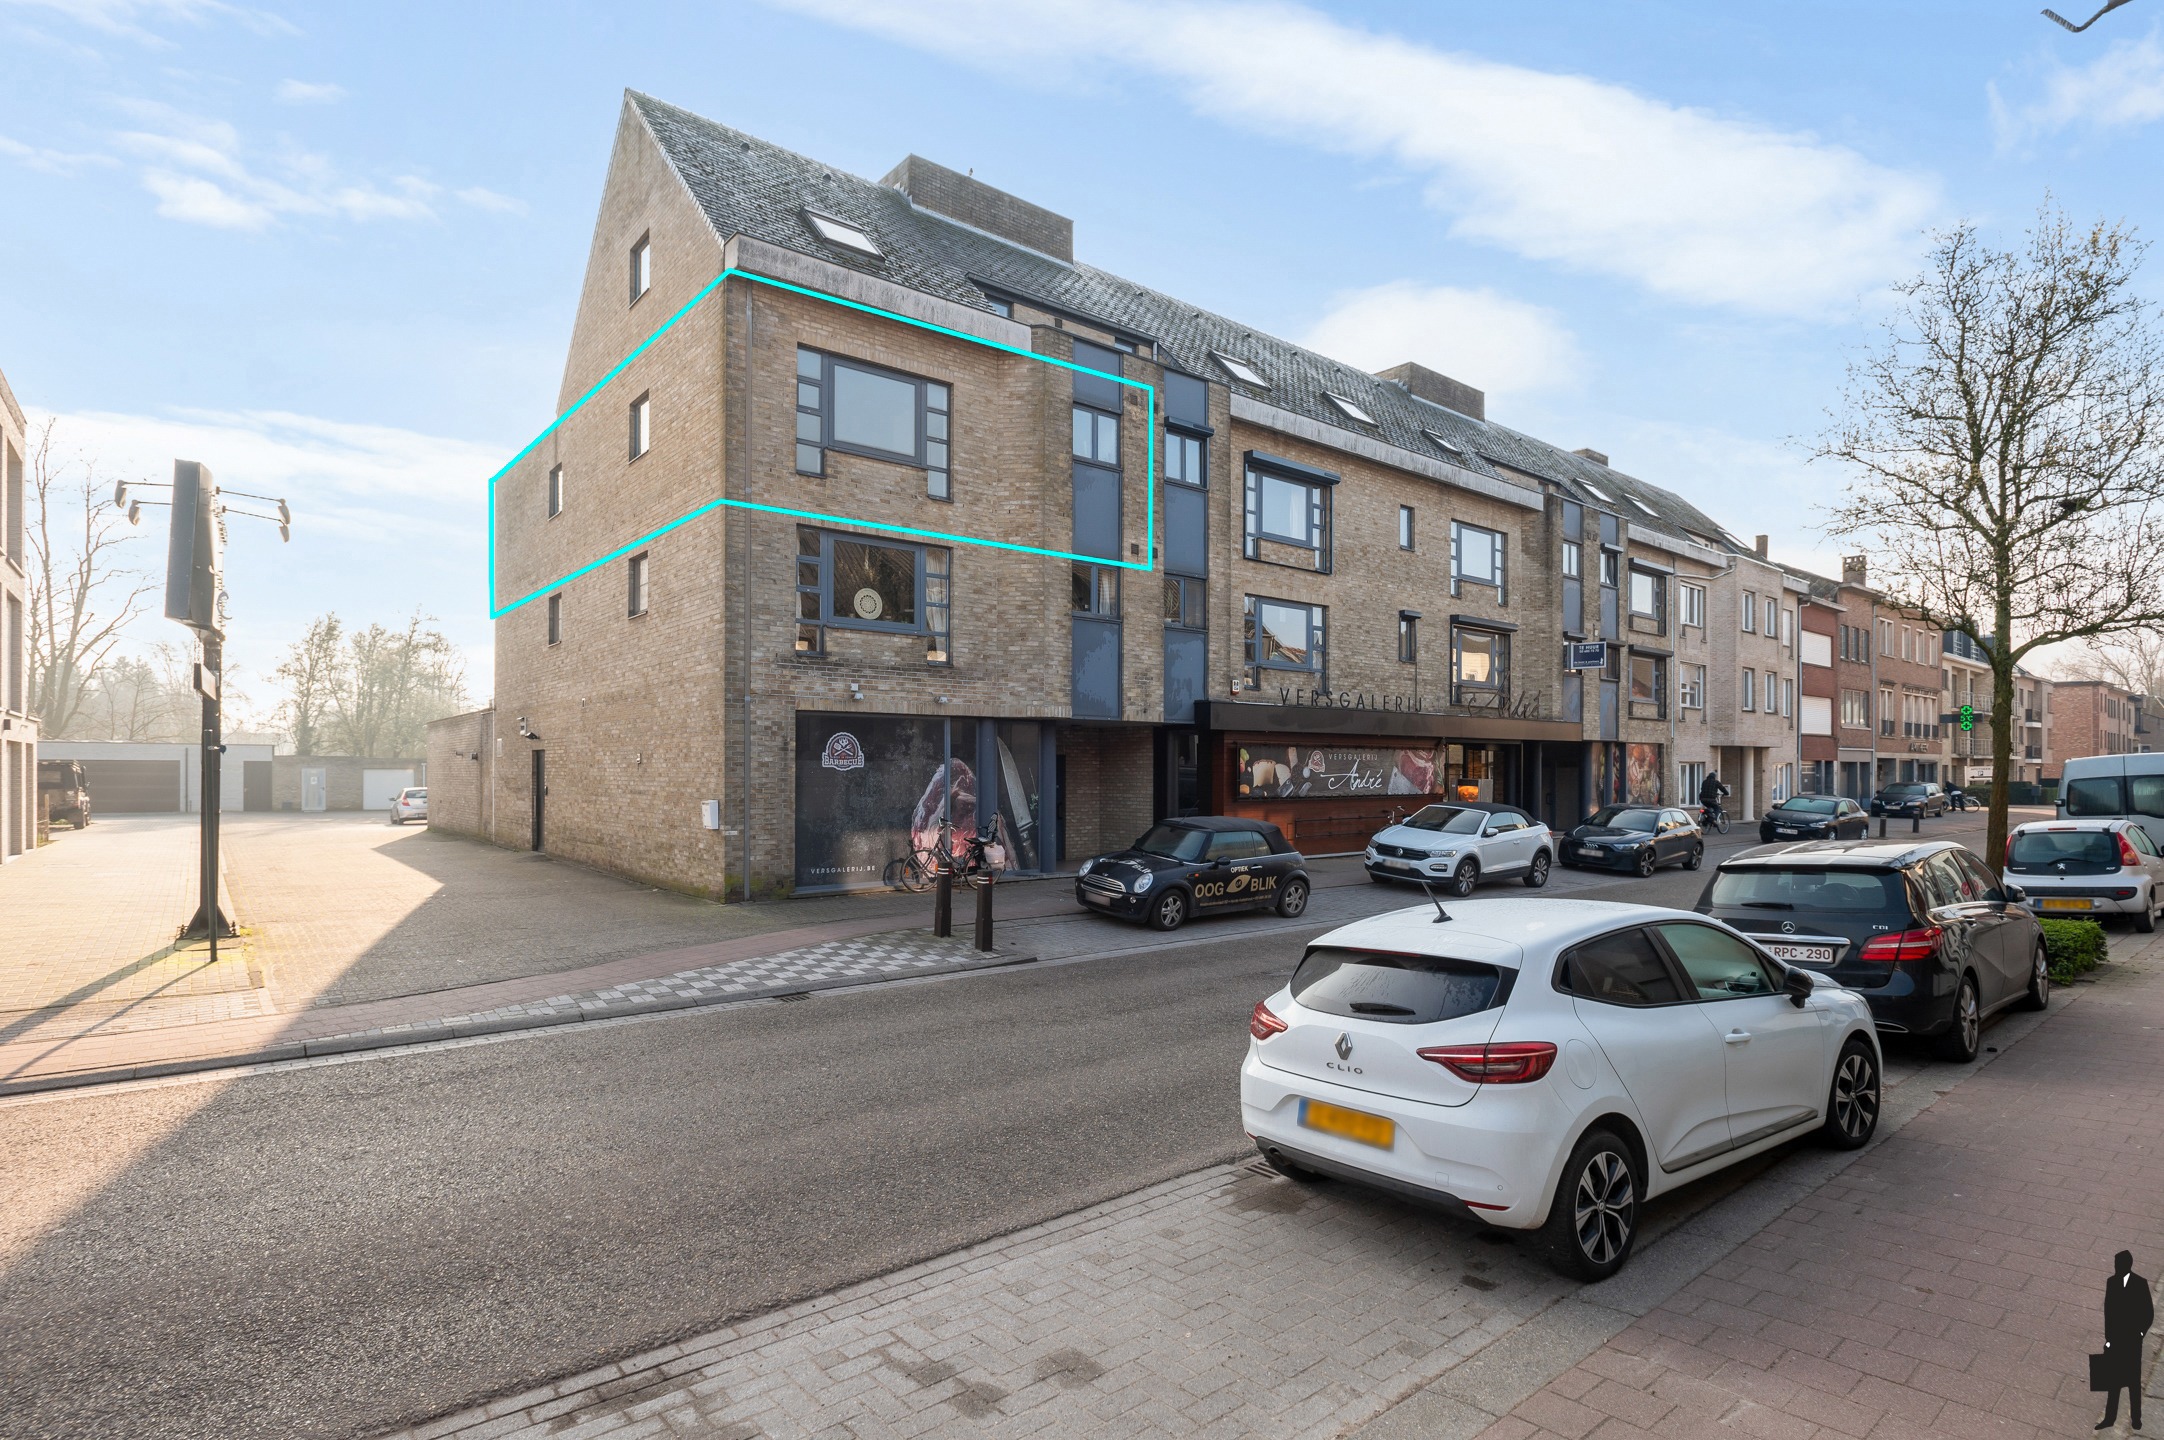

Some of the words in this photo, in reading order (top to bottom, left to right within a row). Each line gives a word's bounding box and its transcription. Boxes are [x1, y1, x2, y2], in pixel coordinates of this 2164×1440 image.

[1279, 687, 1422, 712] VERSGALERIJ
[824, 756, 862, 765] BARBECUE
[1320, 759, 1383, 790] André
[811, 865, 876, 874] VERSGALERIJ.BE
[1194, 882, 1224, 898] OOG
[1250, 875, 1277, 892] BLIK
[1326, 1062, 1363, 1074] CLIO
